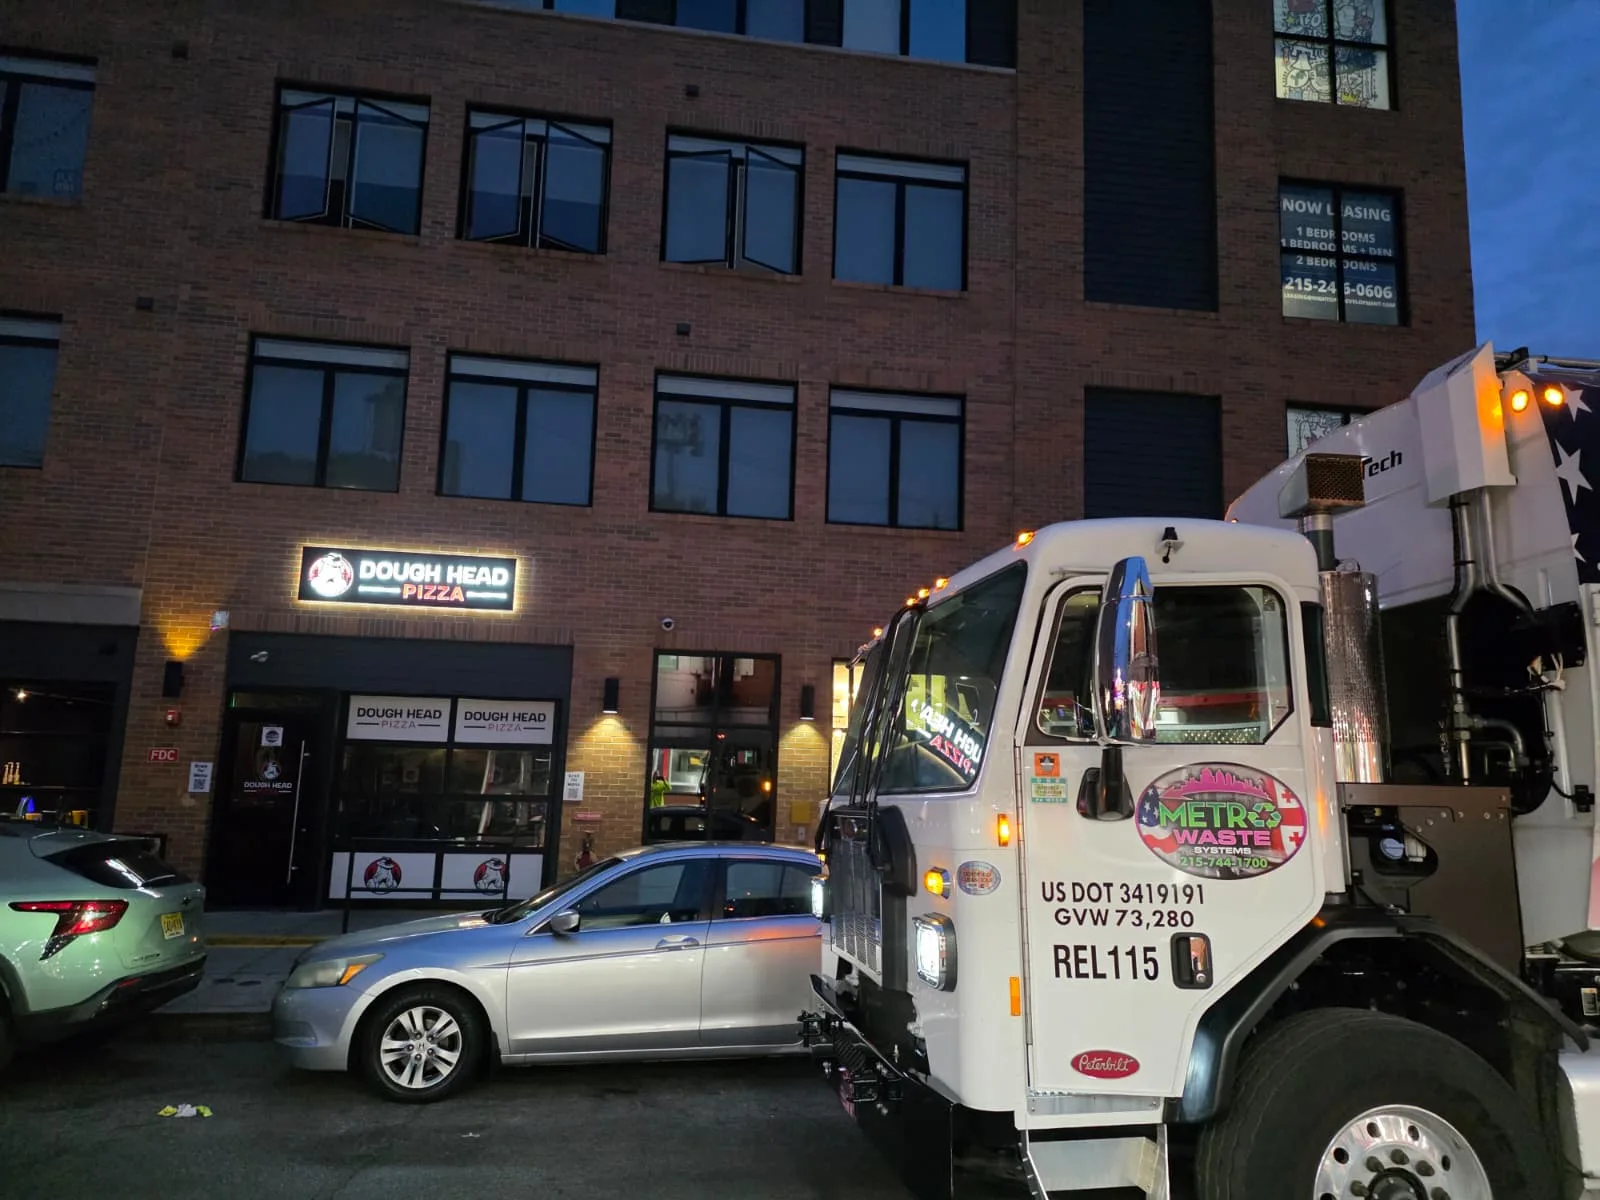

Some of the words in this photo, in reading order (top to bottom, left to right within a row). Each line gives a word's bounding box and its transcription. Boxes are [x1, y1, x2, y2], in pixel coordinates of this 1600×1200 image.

[1282, 198, 1322, 214] NOW
[1326, 203, 1391, 222] LASING
[1296, 227, 1302, 236] 1
[1281, 238, 1286, 247] 1
[1369, 247, 1392, 257] DEN
[1296, 255, 1303, 265] 2
[359, 559, 441, 583] DOUGH
[446, 564, 509, 586] HEAD
[402, 583, 465, 602] PIZZA
[357, 707, 402, 719] DOUGH
[406, 709, 442, 719] HEAD
[464, 711, 508, 722] DOUGH
[512, 712, 546, 722] HEAD
[381, 720, 416, 729] PIZZA
[487, 723, 522, 732] PIZZA
[150, 750, 176, 761] FDC
[243, 781, 270, 789] DOUGH
[272, 782, 292, 790] HEAD
[1172, 829, 1271, 846] WASTE
[1193, 846, 1251, 855] SYSTEMS
[1180, 856, 1268, 869] 215-744-1700
[1041, 881, 1067, 903] US
[1072, 882, 1113, 903] DOT
[1119, 883, 1204, 905] 3419191
[1054, 907, 1109, 926] GVW
[1115, 909, 1194, 930] 73,280
[1053, 944, 1159, 981] REL115
[1078, 1054, 1134, 1072] Peterbilt
